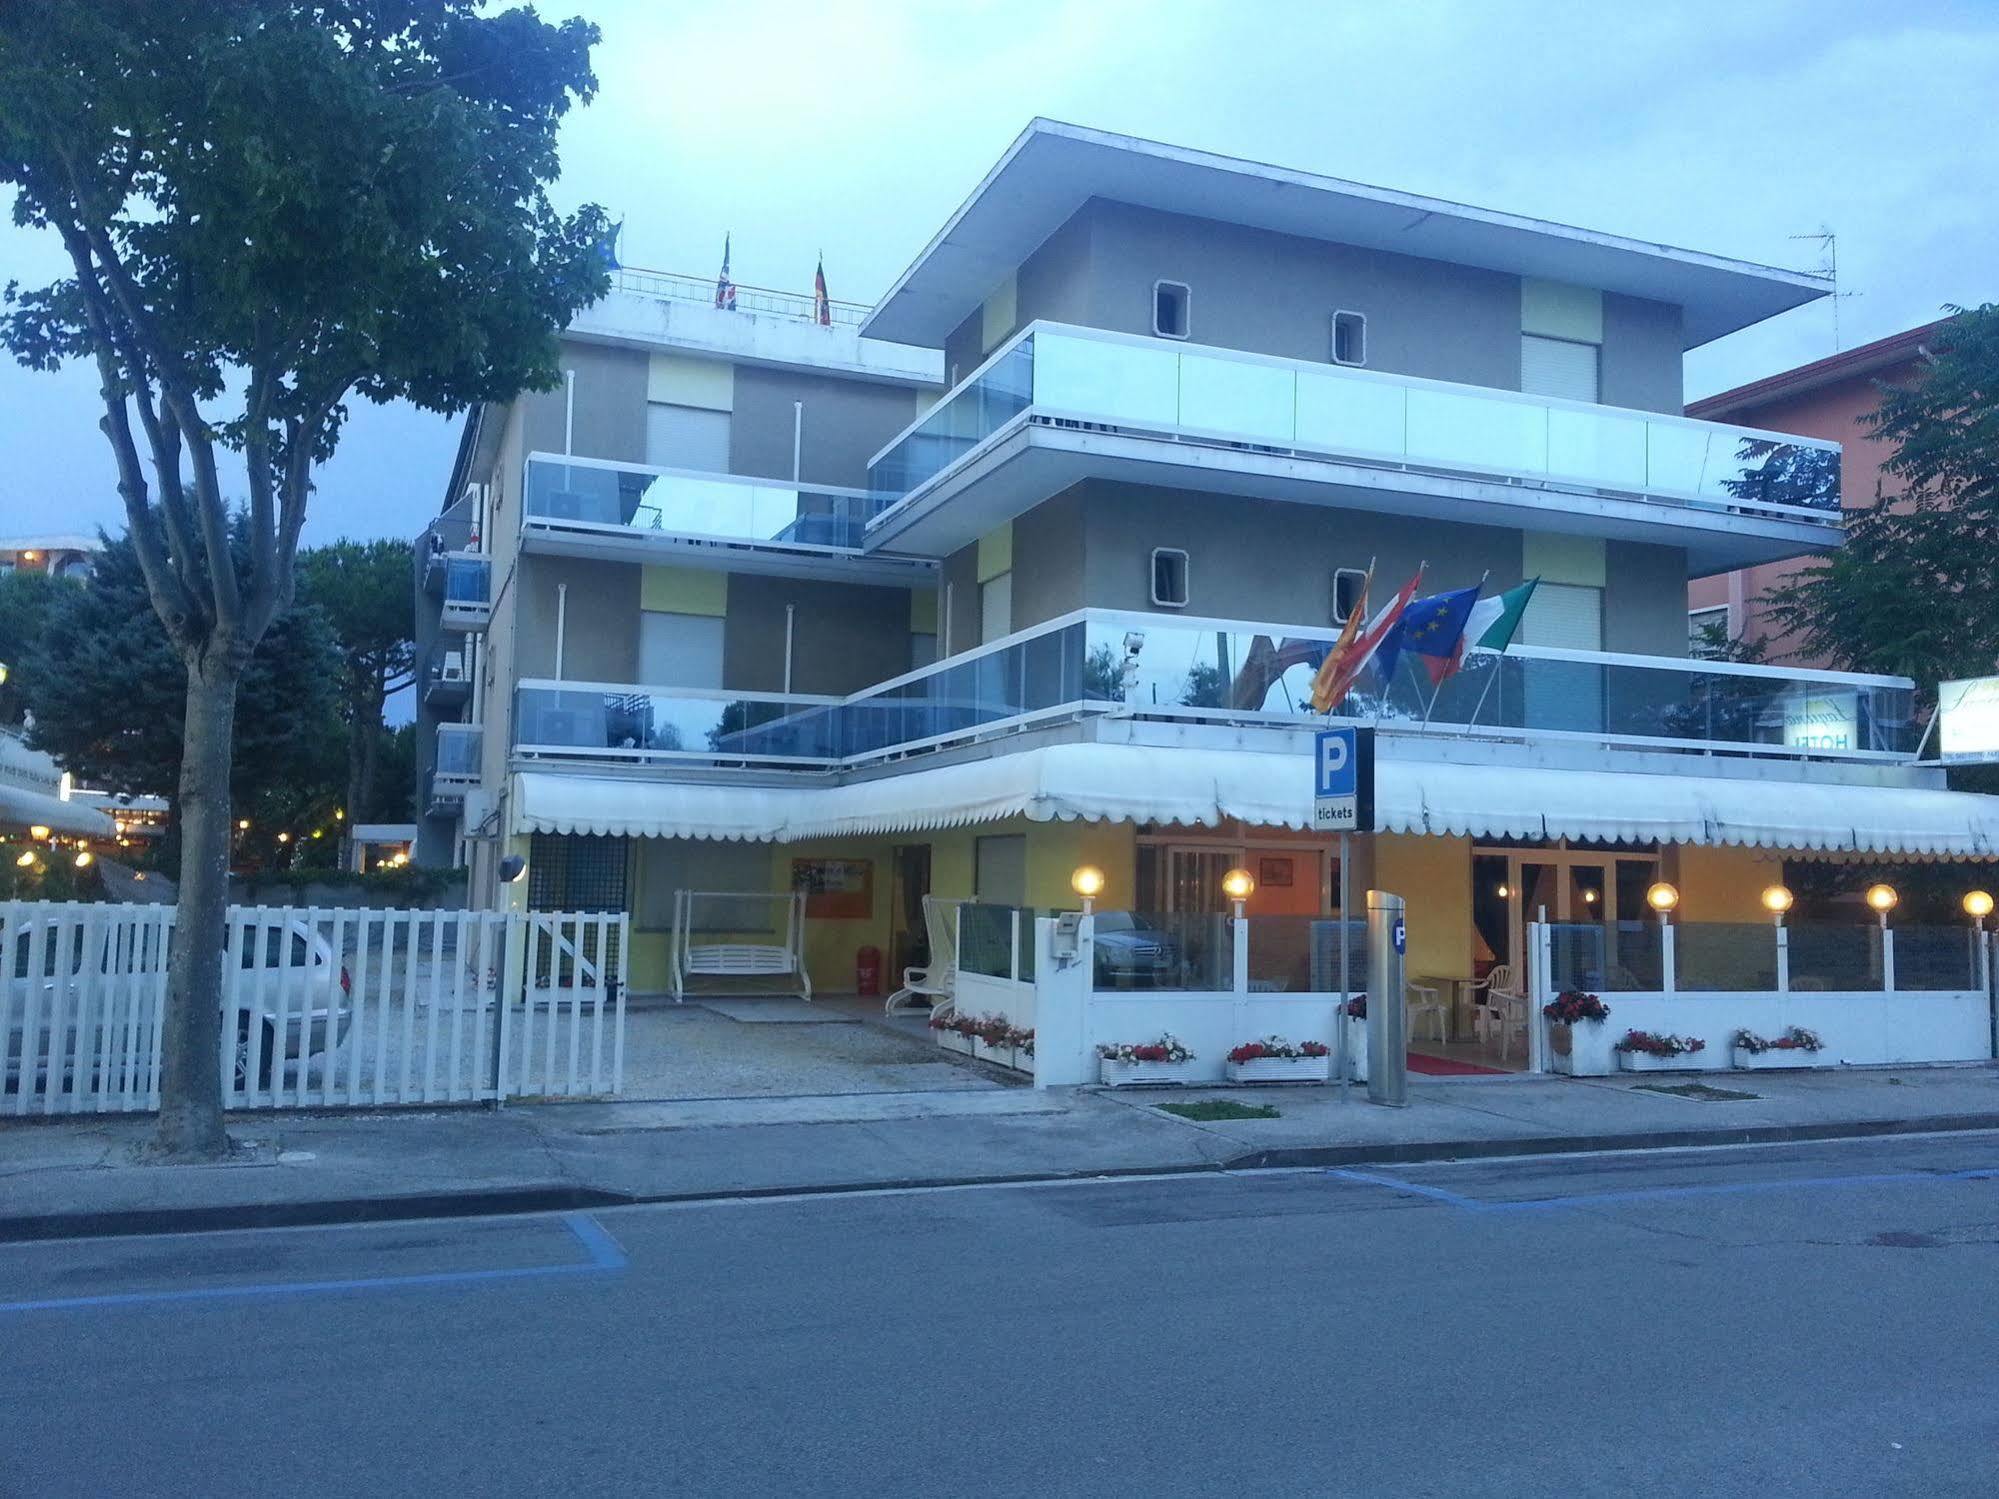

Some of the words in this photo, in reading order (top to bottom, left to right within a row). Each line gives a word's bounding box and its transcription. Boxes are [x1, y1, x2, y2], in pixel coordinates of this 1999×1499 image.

[1322, 736, 1347, 790] P
[1318, 807, 1353, 820] tickets
[1395, 926, 1405, 946] P
